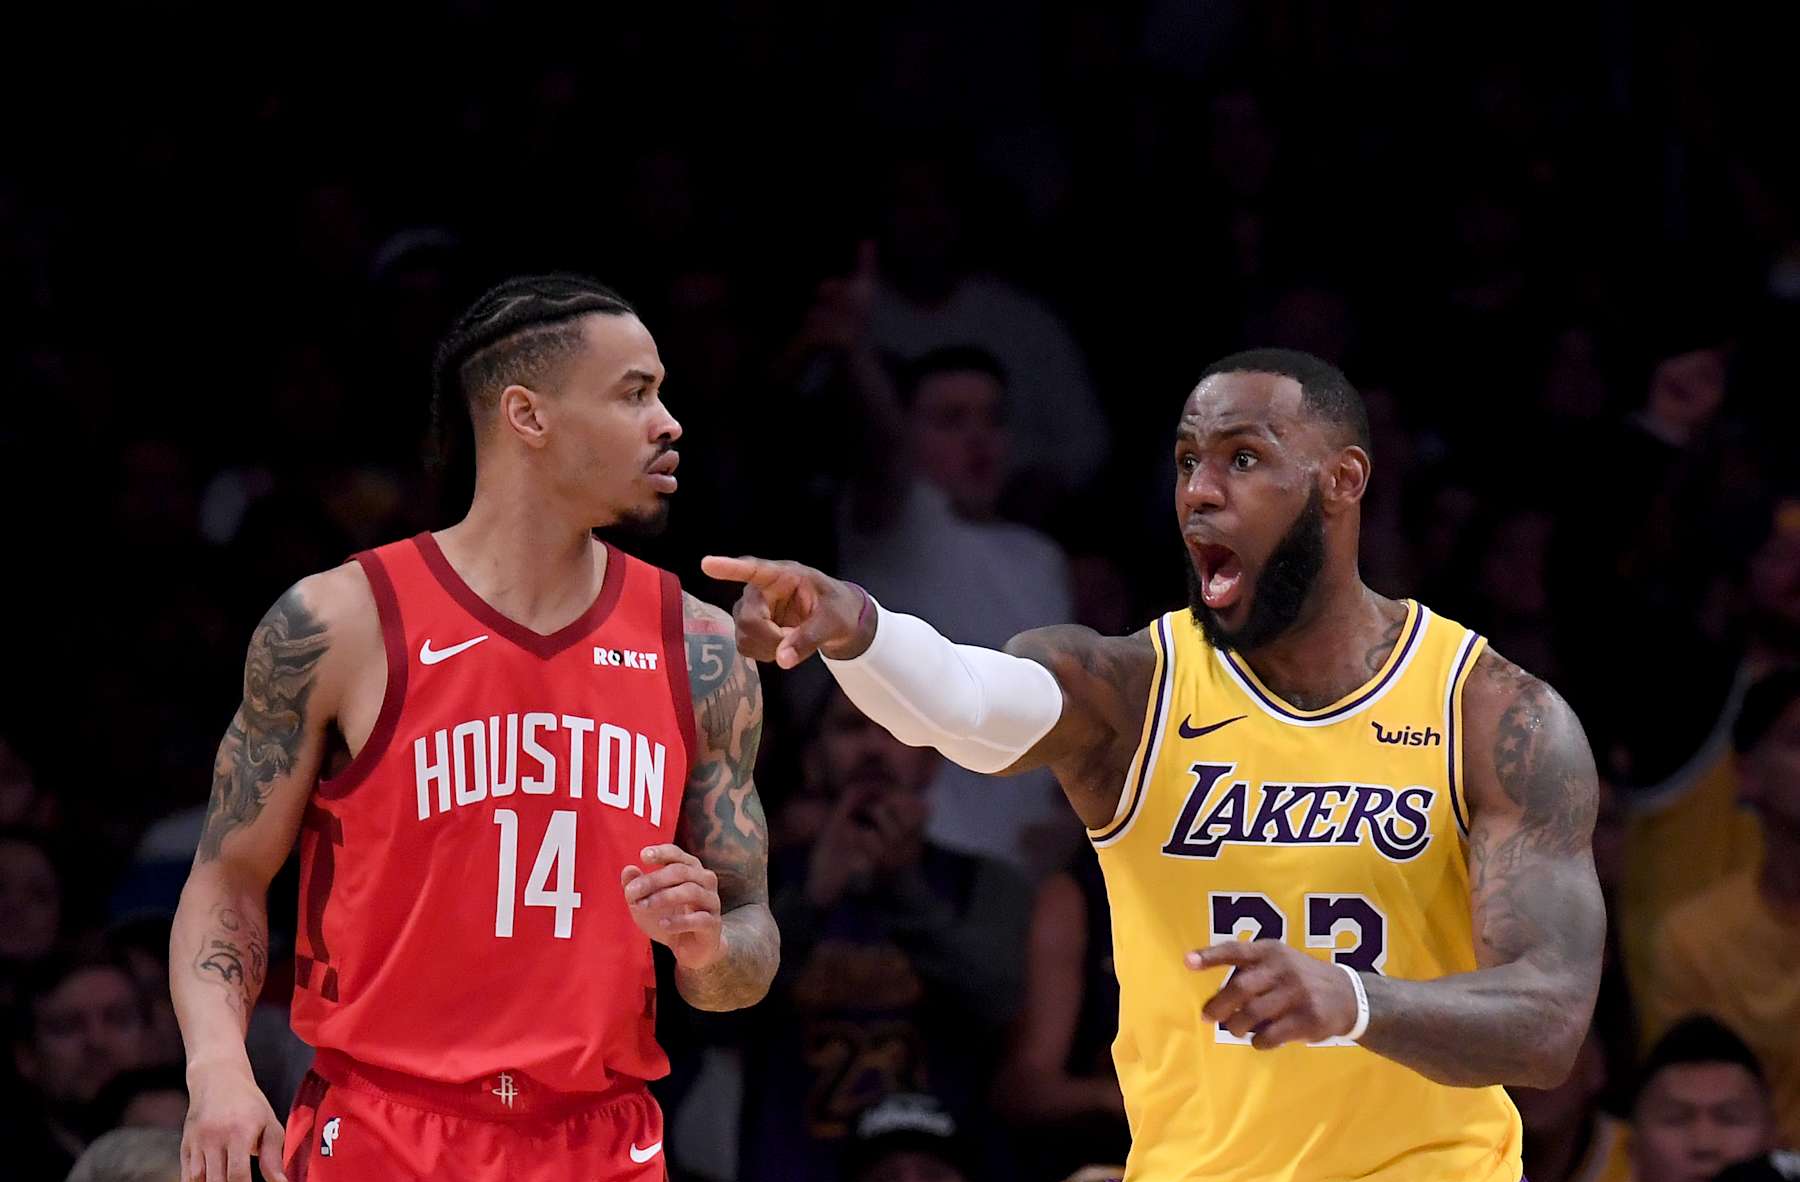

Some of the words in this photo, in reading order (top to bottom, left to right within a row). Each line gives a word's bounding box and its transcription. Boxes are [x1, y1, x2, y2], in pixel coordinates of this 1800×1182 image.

[414, 712, 666, 828] HOUSTON
[1371, 720, 1441, 746] wish
[1160, 761, 1438, 864] LAKERS
[493, 808, 582, 939] 14
